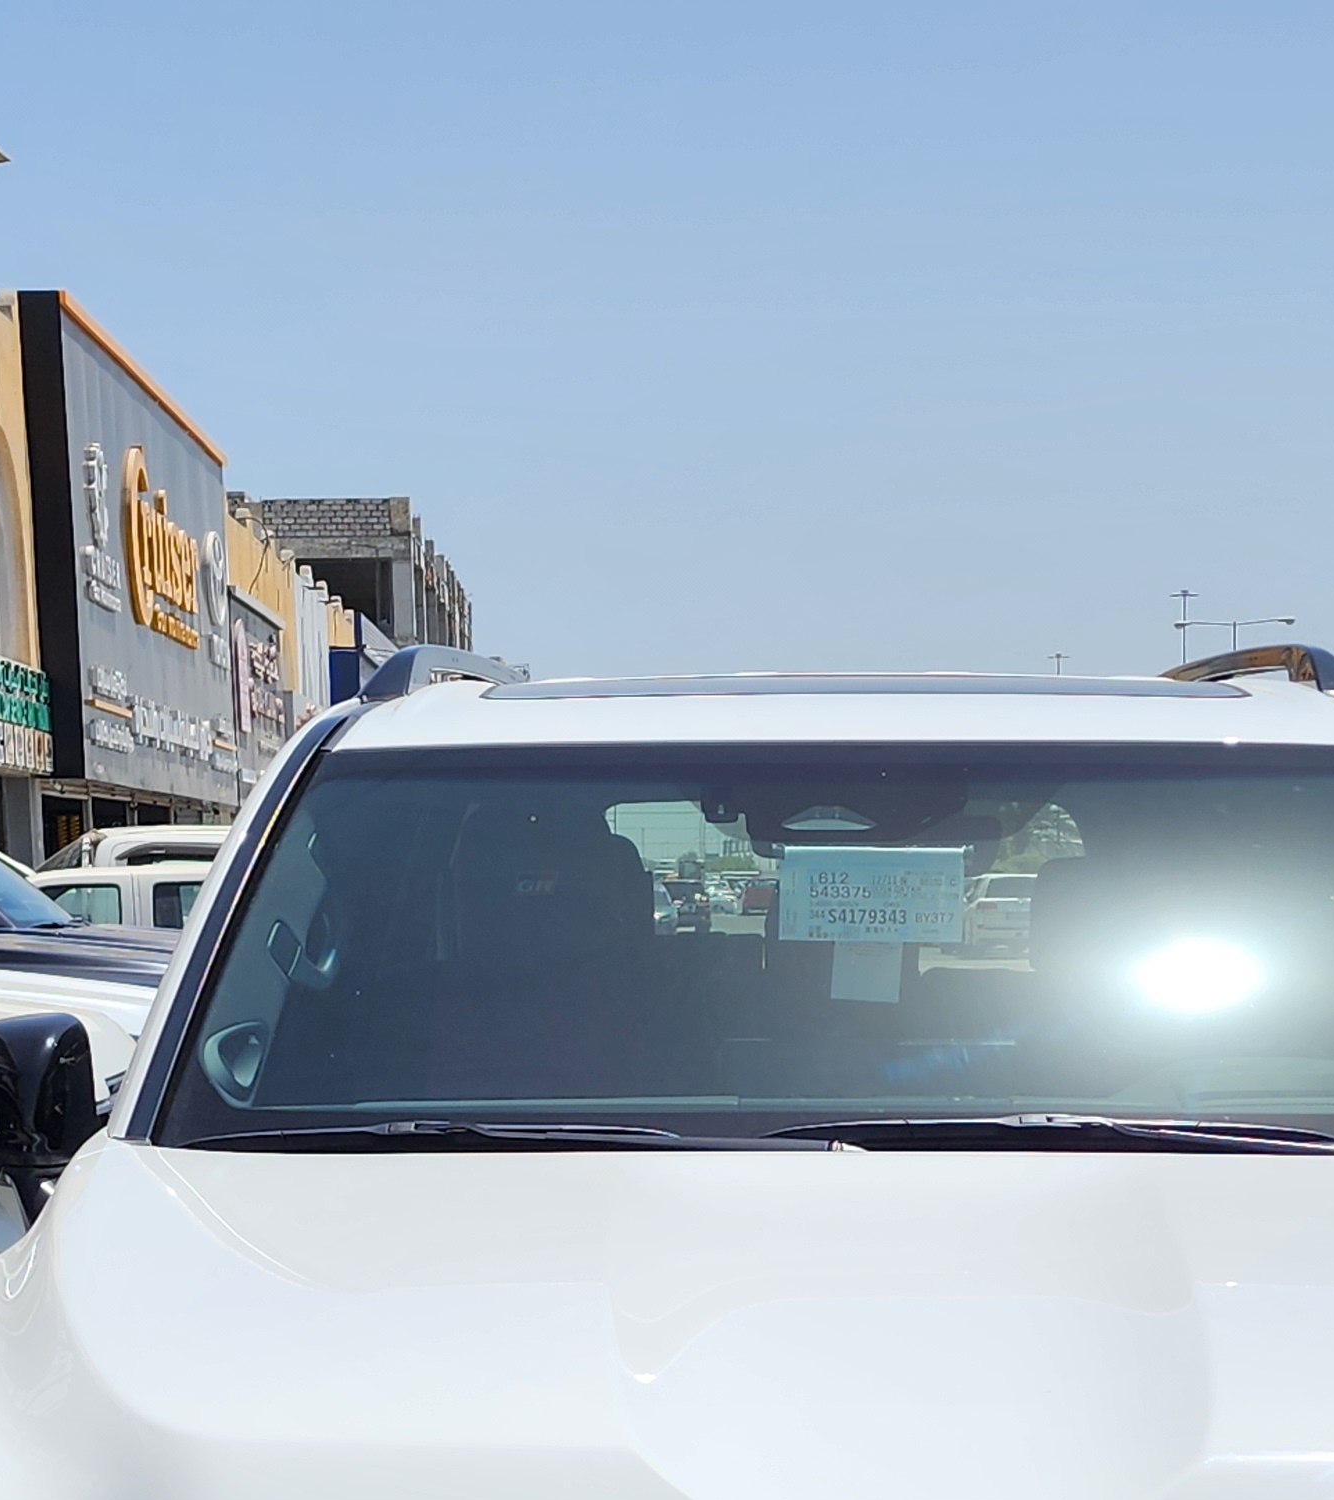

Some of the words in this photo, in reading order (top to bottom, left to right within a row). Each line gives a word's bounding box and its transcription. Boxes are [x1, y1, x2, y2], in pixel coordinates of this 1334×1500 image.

[122, 445, 200, 626] Cruiser
[818, 872, 849, 885] 612
[809, 885, 871, 898] 543375
[827, 909, 907, 925] S4179343
[914, 912, 954, 923] BY3T7
